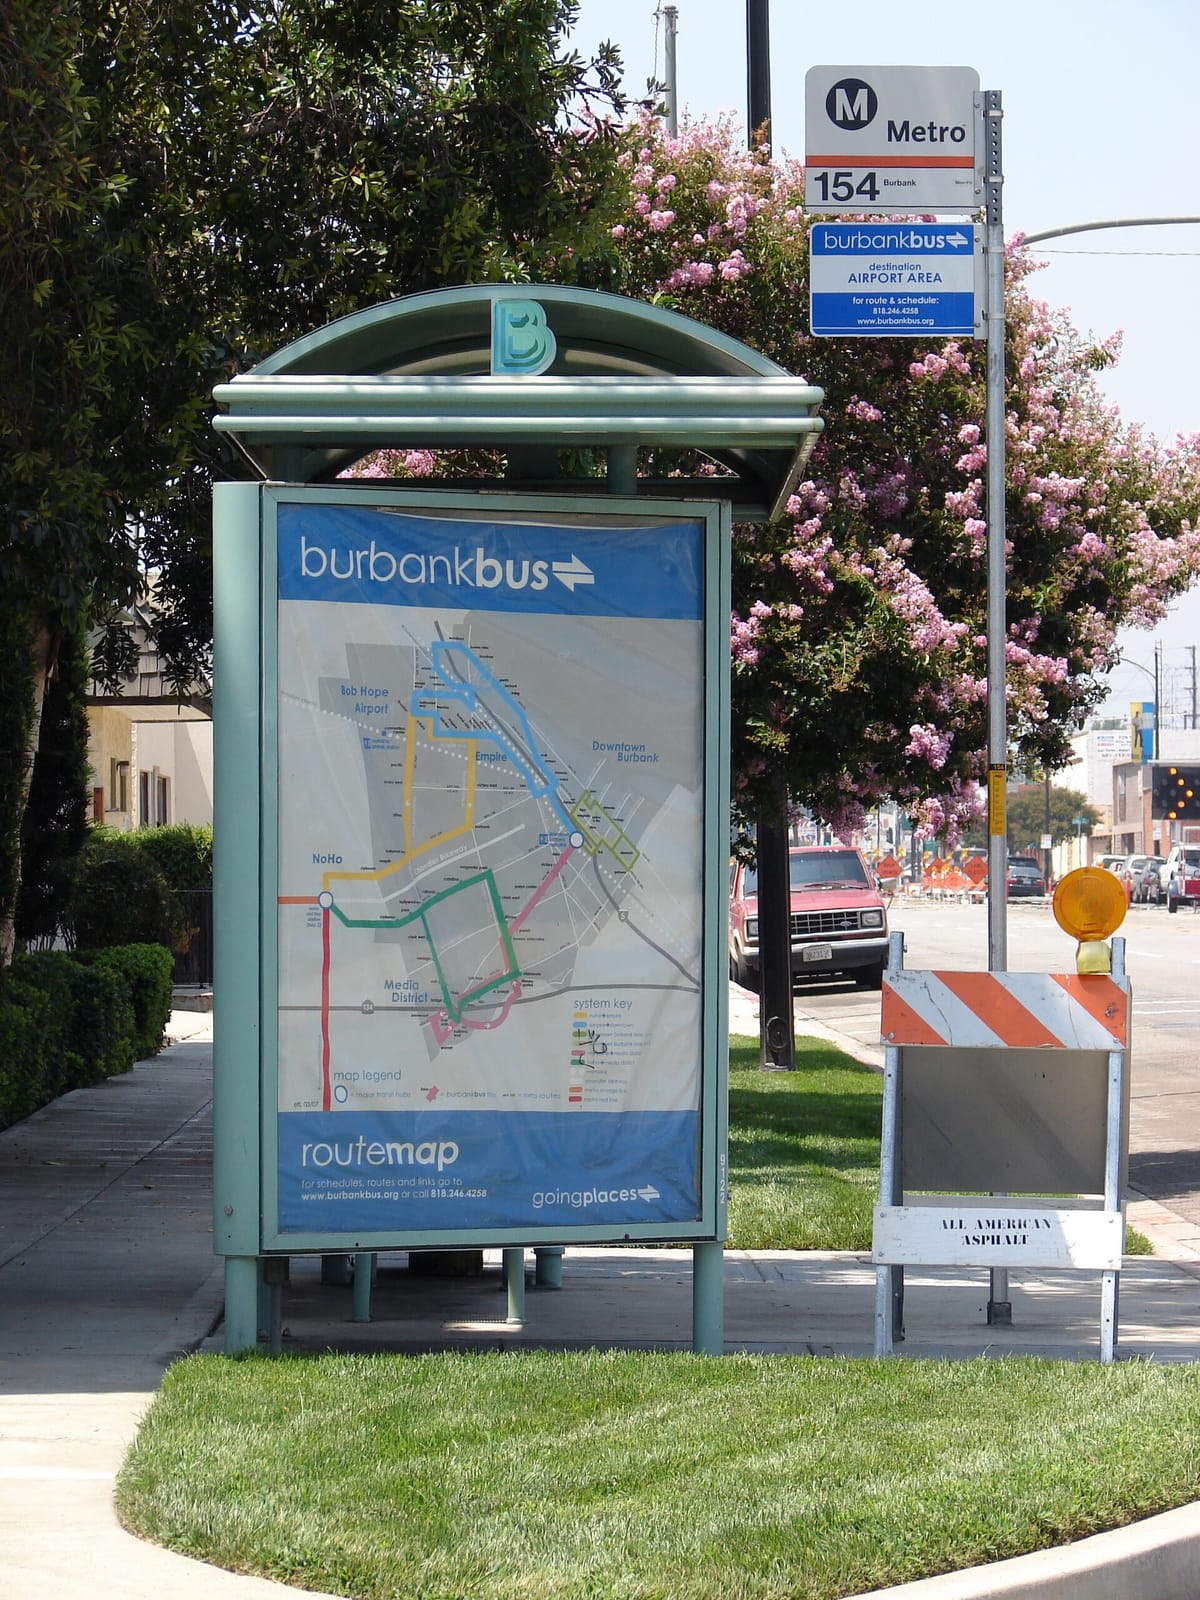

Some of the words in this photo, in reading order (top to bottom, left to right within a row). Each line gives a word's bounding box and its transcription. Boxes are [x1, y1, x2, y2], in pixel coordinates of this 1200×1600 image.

[835, 88, 868, 121] M
[887, 120, 966, 143] Metro
[814, 171, 881, 202] 154
[883, 179, 917, 187] Burbank
[824, 231, 945, 249] burbankbus
[869, 262, 921, 271] destination
[848, 272, 903, 284] AIRPORT
[907, 272, 943, 284] AREA
[852, 296, 864, 305] for
[865, 297, 887, 305] route
[889, 296, 896, 305] &
[897, 296, 939, 305] schedule:
[856, 317, 934, 326] www.burbankbus.org
[491, 299, 557, 376] B
[301, 535, 549, 591] burbankbus
[361, 686, 389, 699] Hope
[355, 703, 388, 716] Airport
[592, 741, 646, 752] Downtown
[475, 751, 508, 762] Empire
[617, 752, 659, 763] Burbank
[312, 854, 343, 864] NoHo
[384, 979, 419, 991] Media
[391, 992, 428, 1003] District
[574, 998, 610, 1010] system
[614, 998, 633, 1011] key
[334, 1071, 360, 1082] map
[362, 1070, 402, 1082] legend
[302, 1136, 459, 1172] routemap
[302, 1179, 315, 1188] for
[317, 1178, 366, 1188] schedules,
[367, 1178, 395, 1188] routes
[398, 1177, 416, 1186] and
[417, 1177, 434, 1186] links
[438, 1179, 450, 1187] go
[452, 1177, 462, 1186] to
[302, 1190, 399, 1200] www.burbankbus.org
[401, 1191, 411, 1199] or
[412, 1189, 429, 1198] call
[430, 1189, 487, 1199] 818.246.4258
[532, 1187, 637, 1209] goingplaces
[940, 1219, 967, 1230] ALL
[974, 1218, 1051, 1230] AMERICAN
[962, 1234, 1030, 1246] ASPHALT
